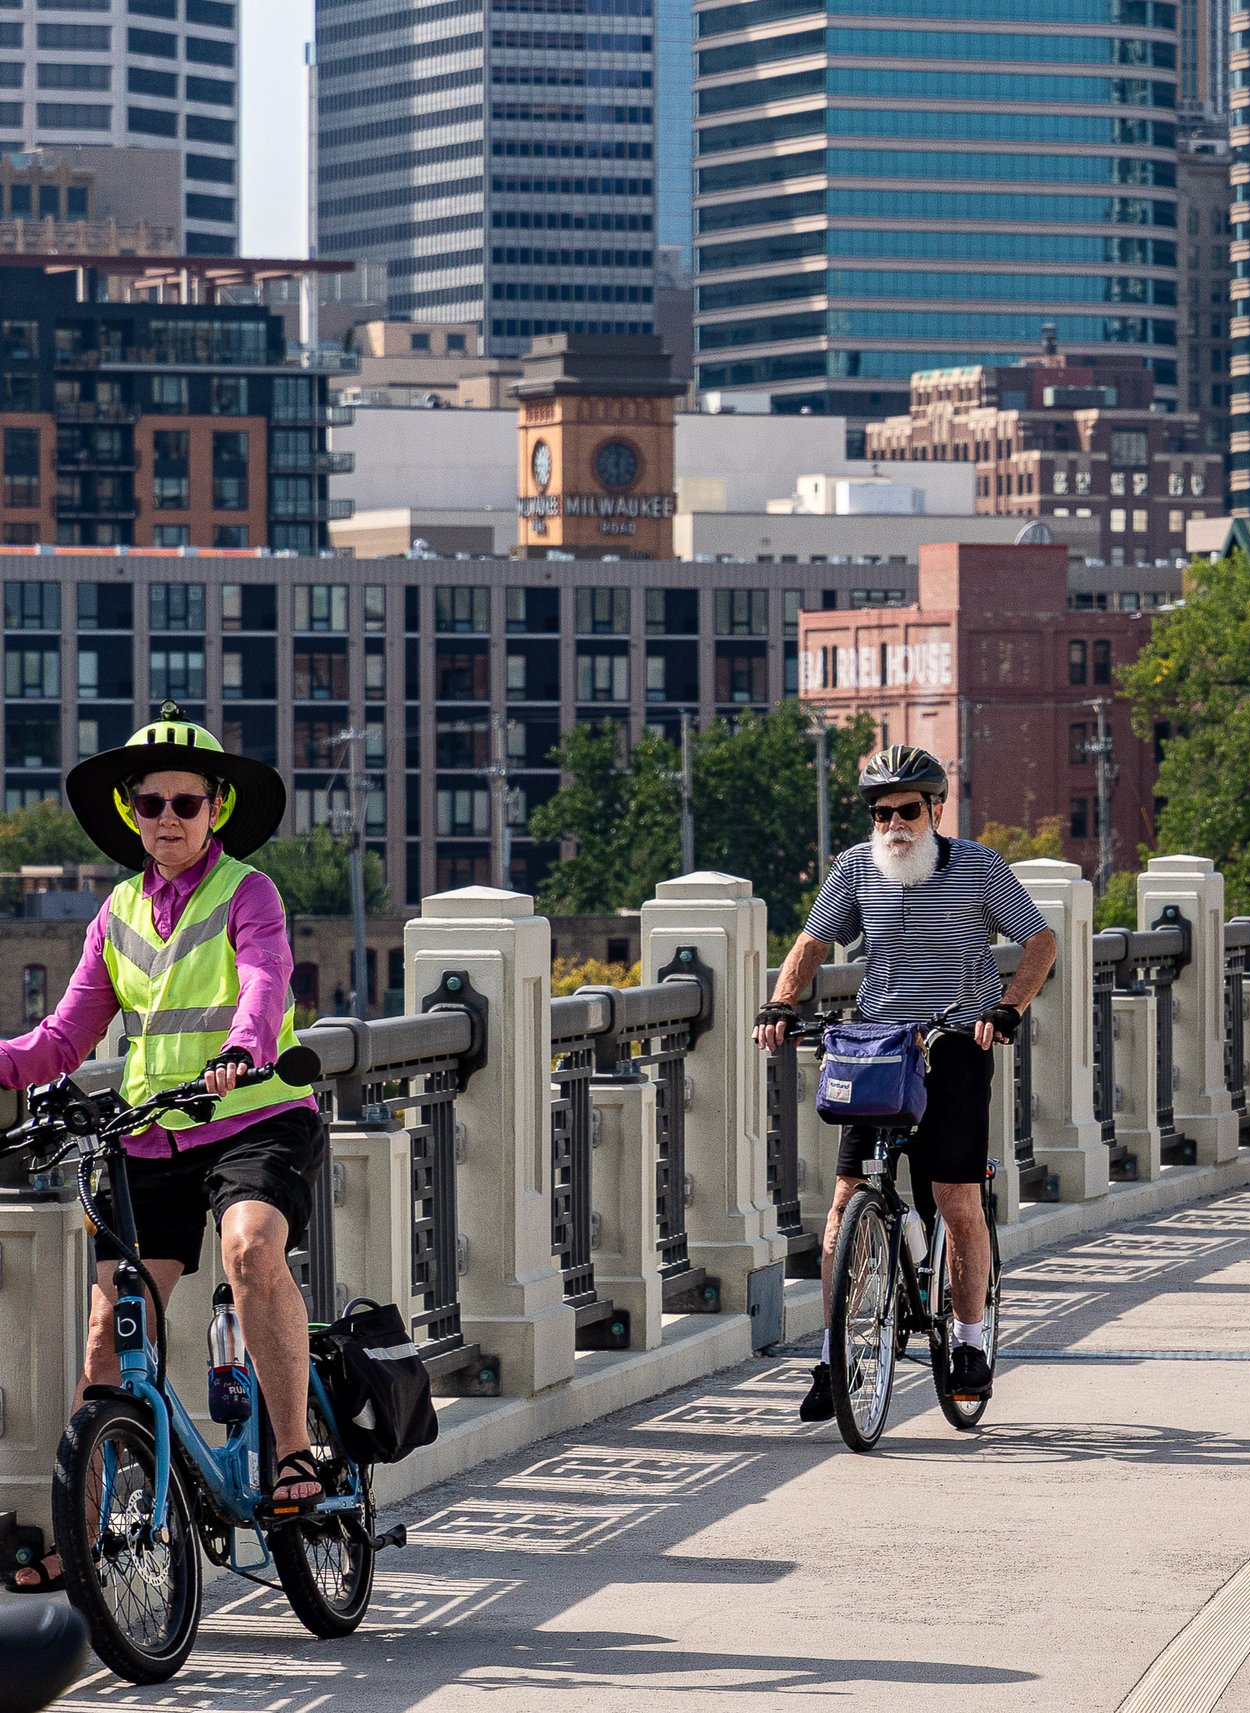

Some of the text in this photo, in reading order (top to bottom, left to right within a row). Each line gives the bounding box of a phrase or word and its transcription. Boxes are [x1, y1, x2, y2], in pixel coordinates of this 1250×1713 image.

[565, 496, 672, 518] MILWAUKEE
[601, 522, 636, 534] ROAD
[887, 643, 951, 685] HOUSE
